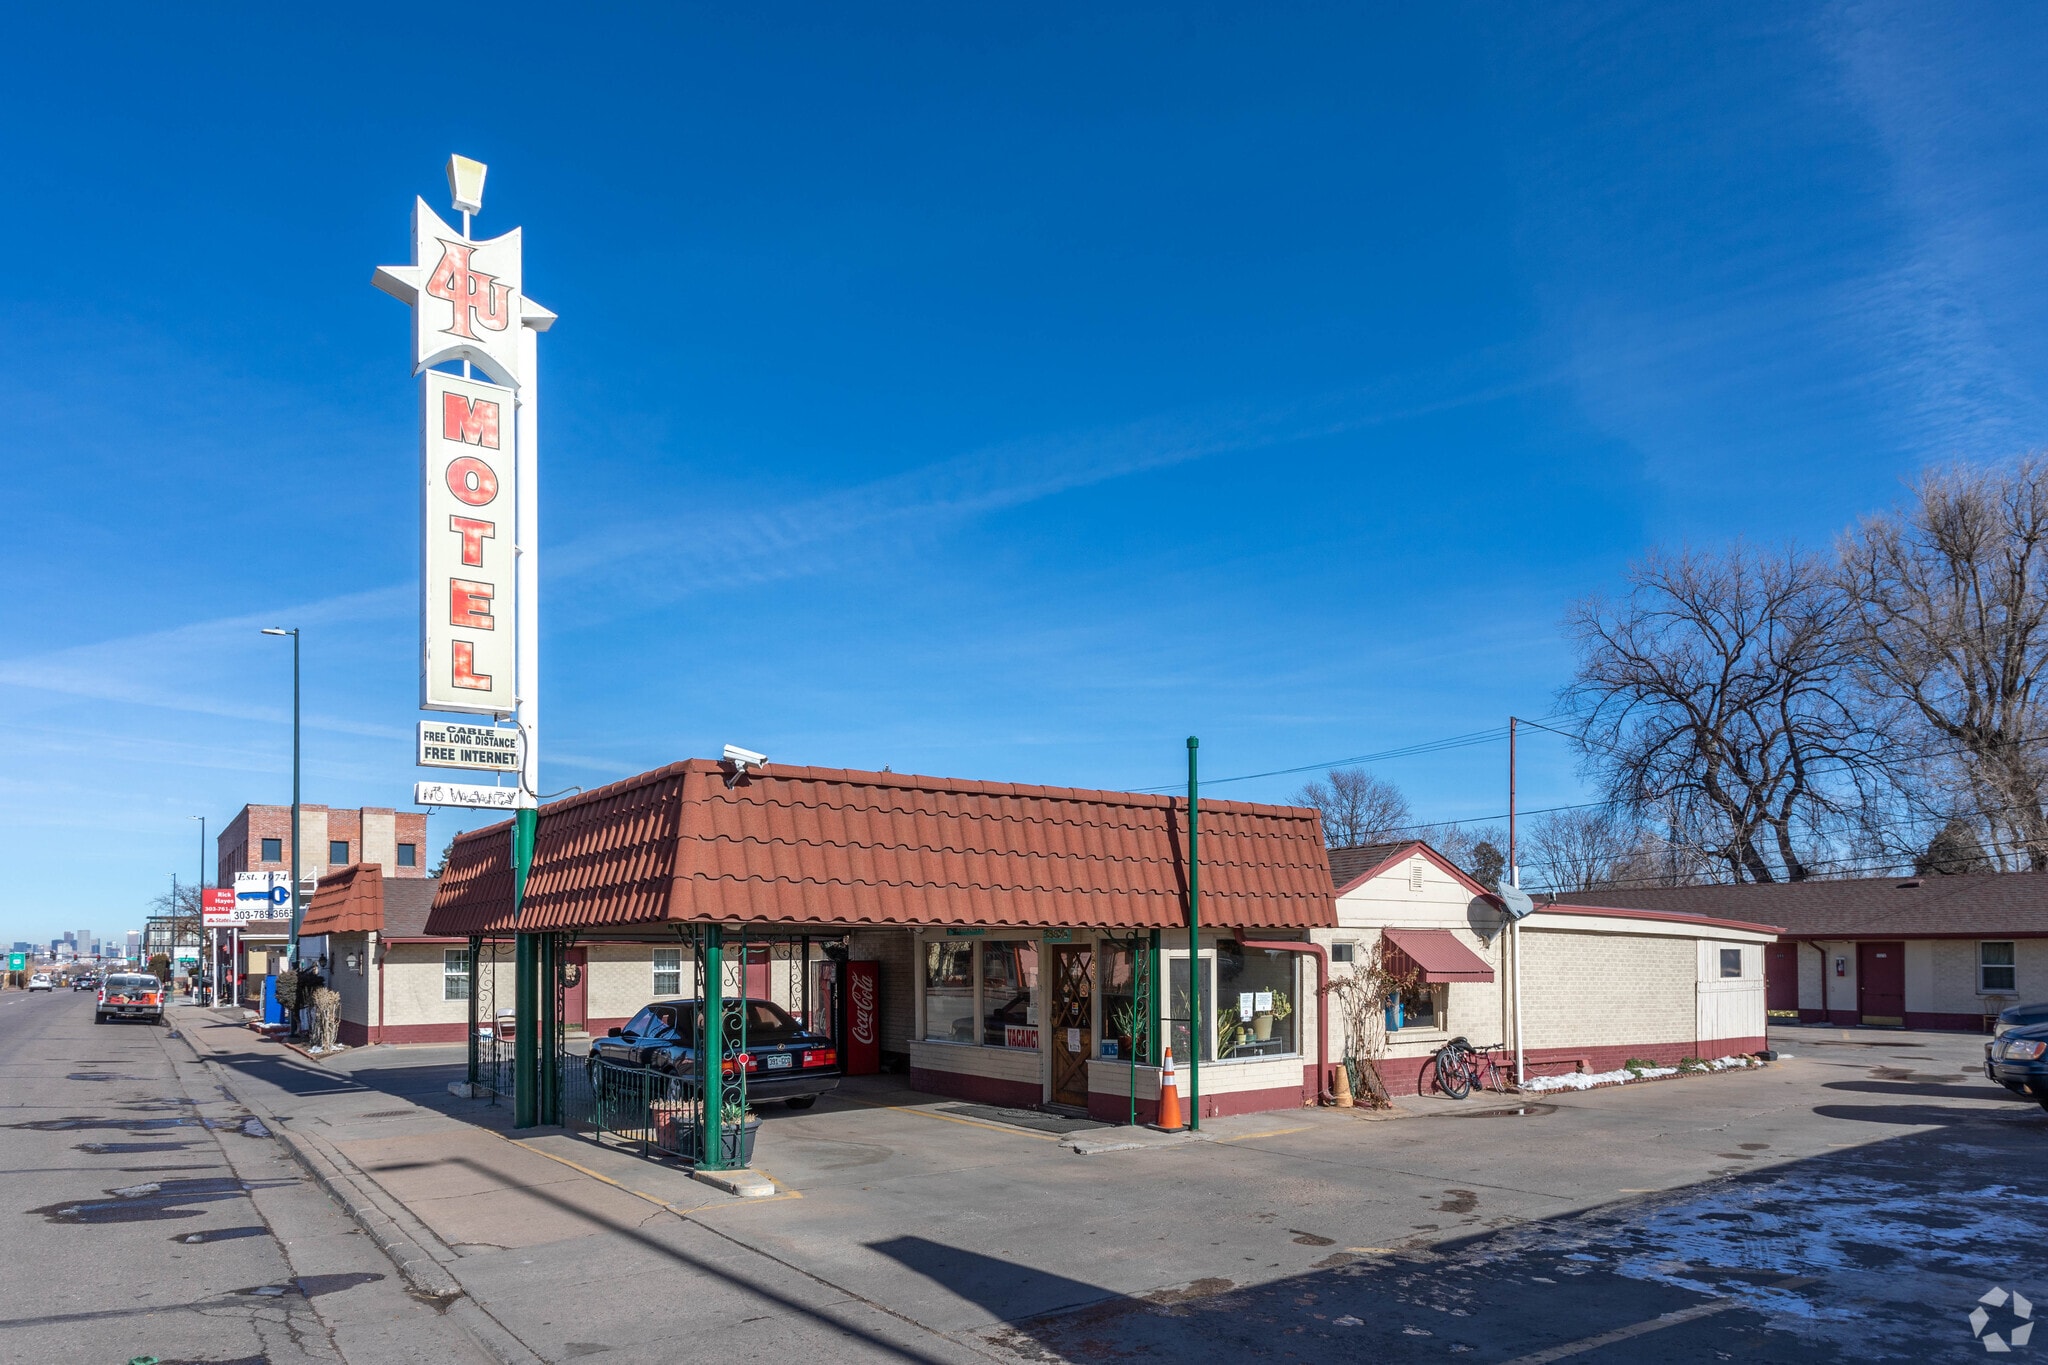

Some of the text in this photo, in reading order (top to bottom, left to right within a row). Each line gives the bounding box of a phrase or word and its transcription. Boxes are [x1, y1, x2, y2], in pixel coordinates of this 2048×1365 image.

[426, 237, 514, 343] 4U
[442, 390, 501, 692] MOTEL
[423, 731, 516, 749] FREE LONG DISTANCE
[446, 725, 495, 737] CABLE
[424, 746, 517, 765] FREE INTERNET
[237, 872, 287, 882] Est. 1974
[233, 908, 294, 920] 303-789-3665
[852, 970, 873, 1044] Coca-Cola
